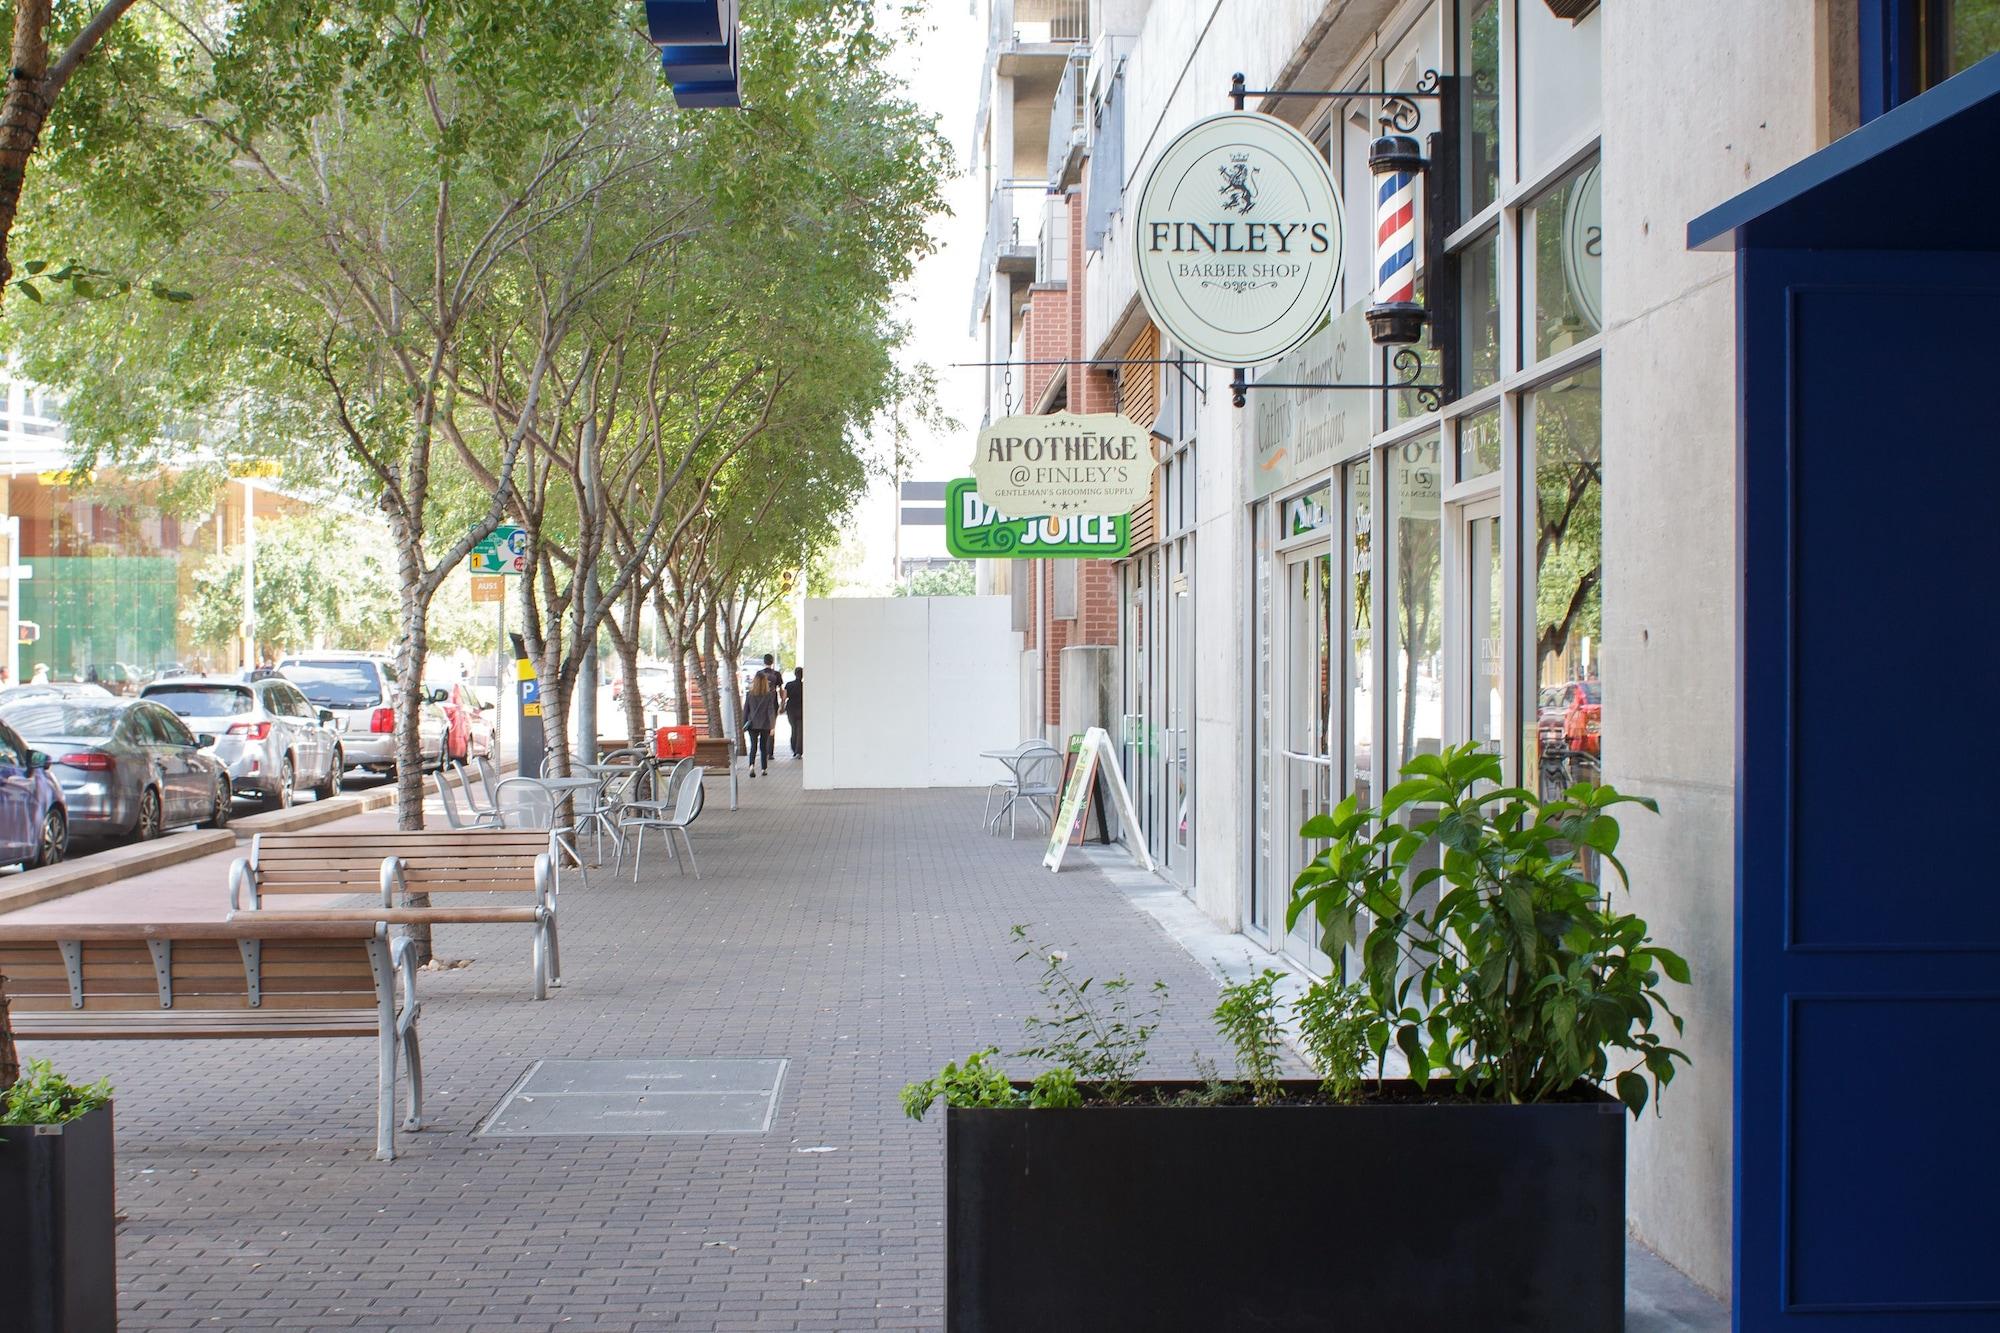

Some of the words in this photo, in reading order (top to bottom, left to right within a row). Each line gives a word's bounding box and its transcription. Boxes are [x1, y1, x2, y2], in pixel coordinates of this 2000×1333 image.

[1148, 221, 1329, 254] FINLEY'S
[1179, 263, 1247, 278] BARBER
[1252, 263, 1301, 278] SHOP
[1009, 465, 1031, 487] @
[1036, 466, 1128, 483] FINLEY'S
[994, 489, 1054, 497] GENTLEMAN'S
[1055, 488, 1102, 496] GROOMING
[1104, 487, 1134, 496] SUPPLY
[1020, 513, 1118, 545] JUICE
[522, 682, 535, 700] P
